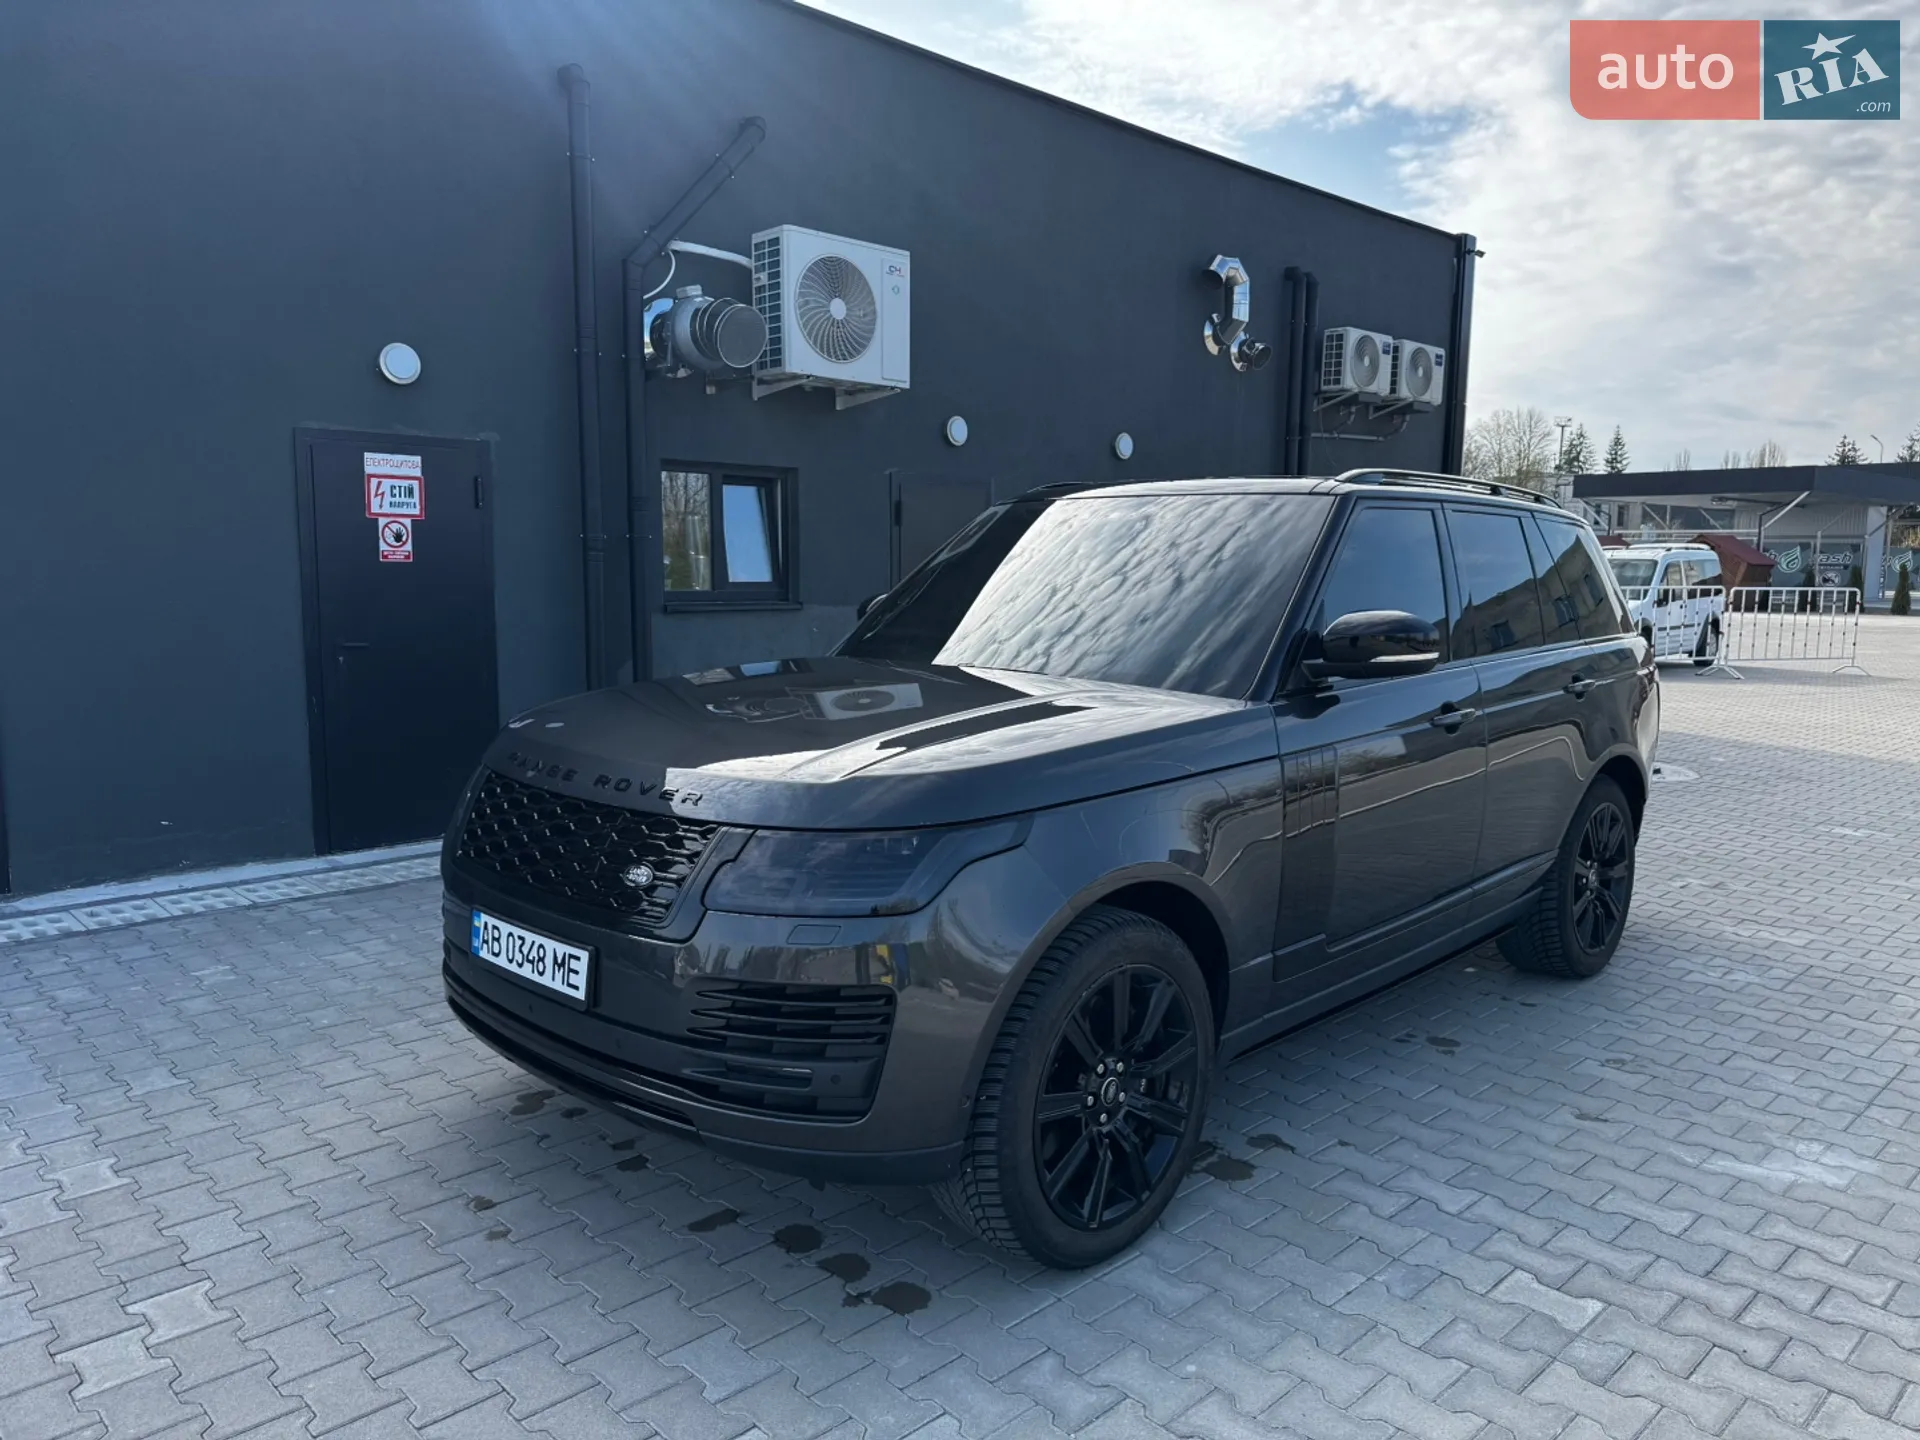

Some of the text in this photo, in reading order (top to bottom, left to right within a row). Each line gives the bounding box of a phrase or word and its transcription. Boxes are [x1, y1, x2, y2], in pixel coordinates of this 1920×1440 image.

[390, 483, 415, 499] СТІЙ
[593, 774, 704, 807] ROVER
[480, 921, 581, 992] AB 0348 ME
